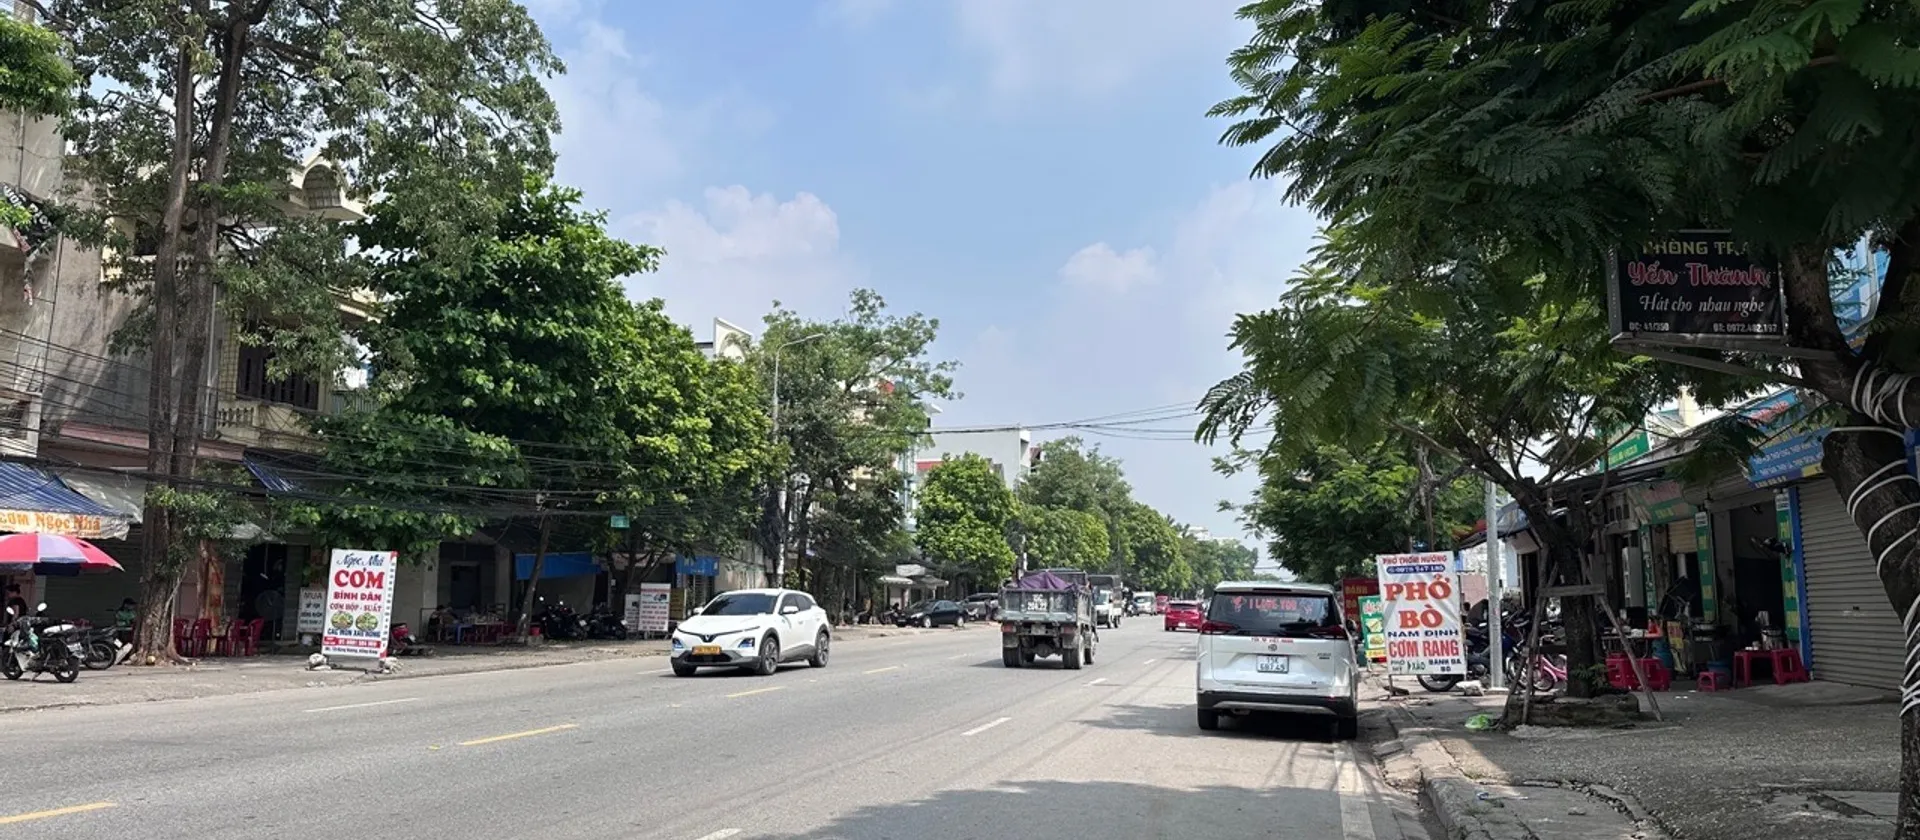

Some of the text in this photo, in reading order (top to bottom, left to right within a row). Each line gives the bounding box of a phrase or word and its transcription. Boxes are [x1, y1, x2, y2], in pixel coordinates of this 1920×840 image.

[1639, 292, 1764, 317] Hát cho nhau nghe
[334, 567, 386, 589] CƠM
[1383, 573, 1452, 602] PHỞ
[1399, 604, 1444, 629] BÒ
[1389, 640, 1460, 658] CƠM RANG
